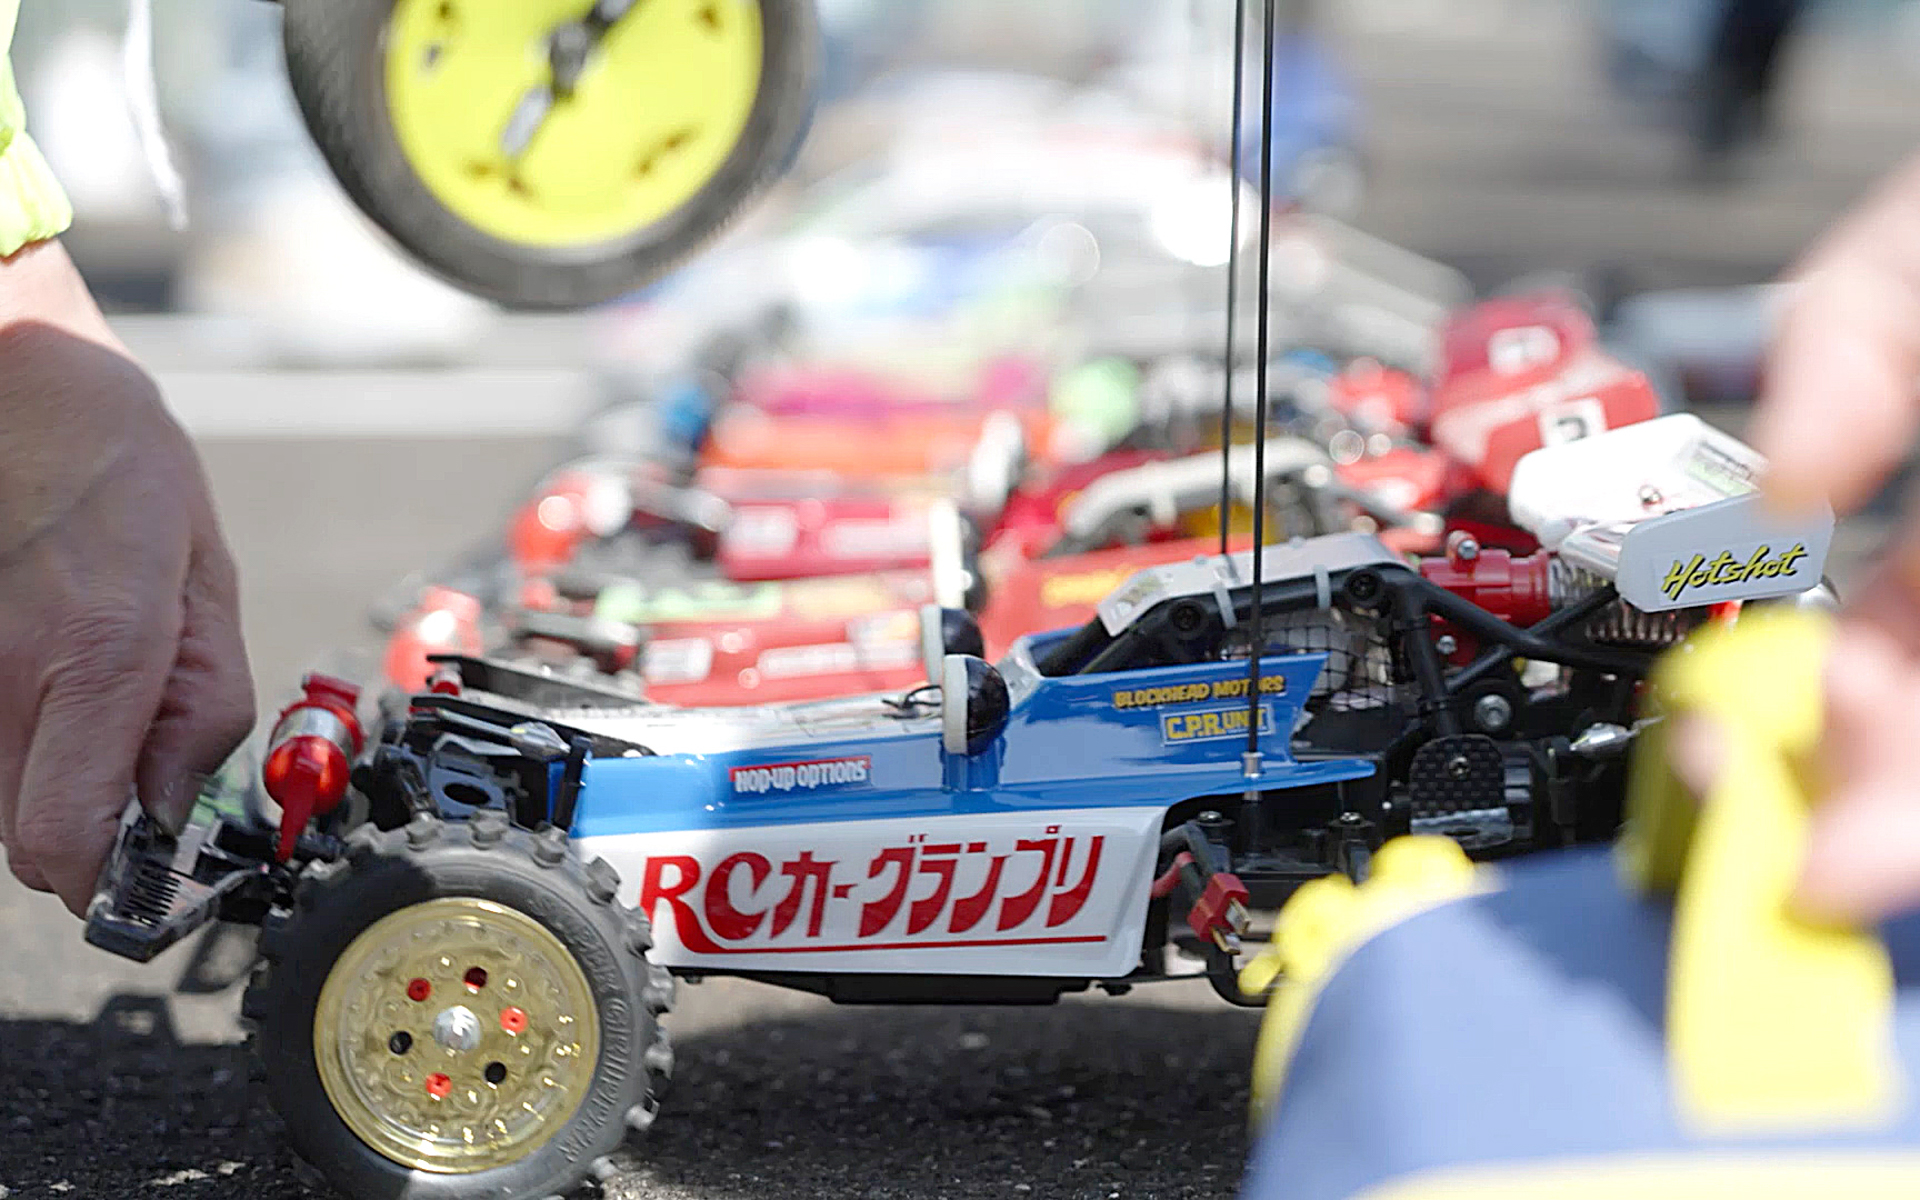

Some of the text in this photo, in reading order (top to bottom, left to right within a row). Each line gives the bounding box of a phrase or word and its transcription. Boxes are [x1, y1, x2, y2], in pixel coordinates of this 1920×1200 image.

[1661, 543, 1808, 600] Hotshot
[1115, 675, 1285, 708] BLOCKHEAD MOTRS
[1222, 708, 1267, 730] UNT
[735, 760, 867, 793] HOP-UP OPTIONS
